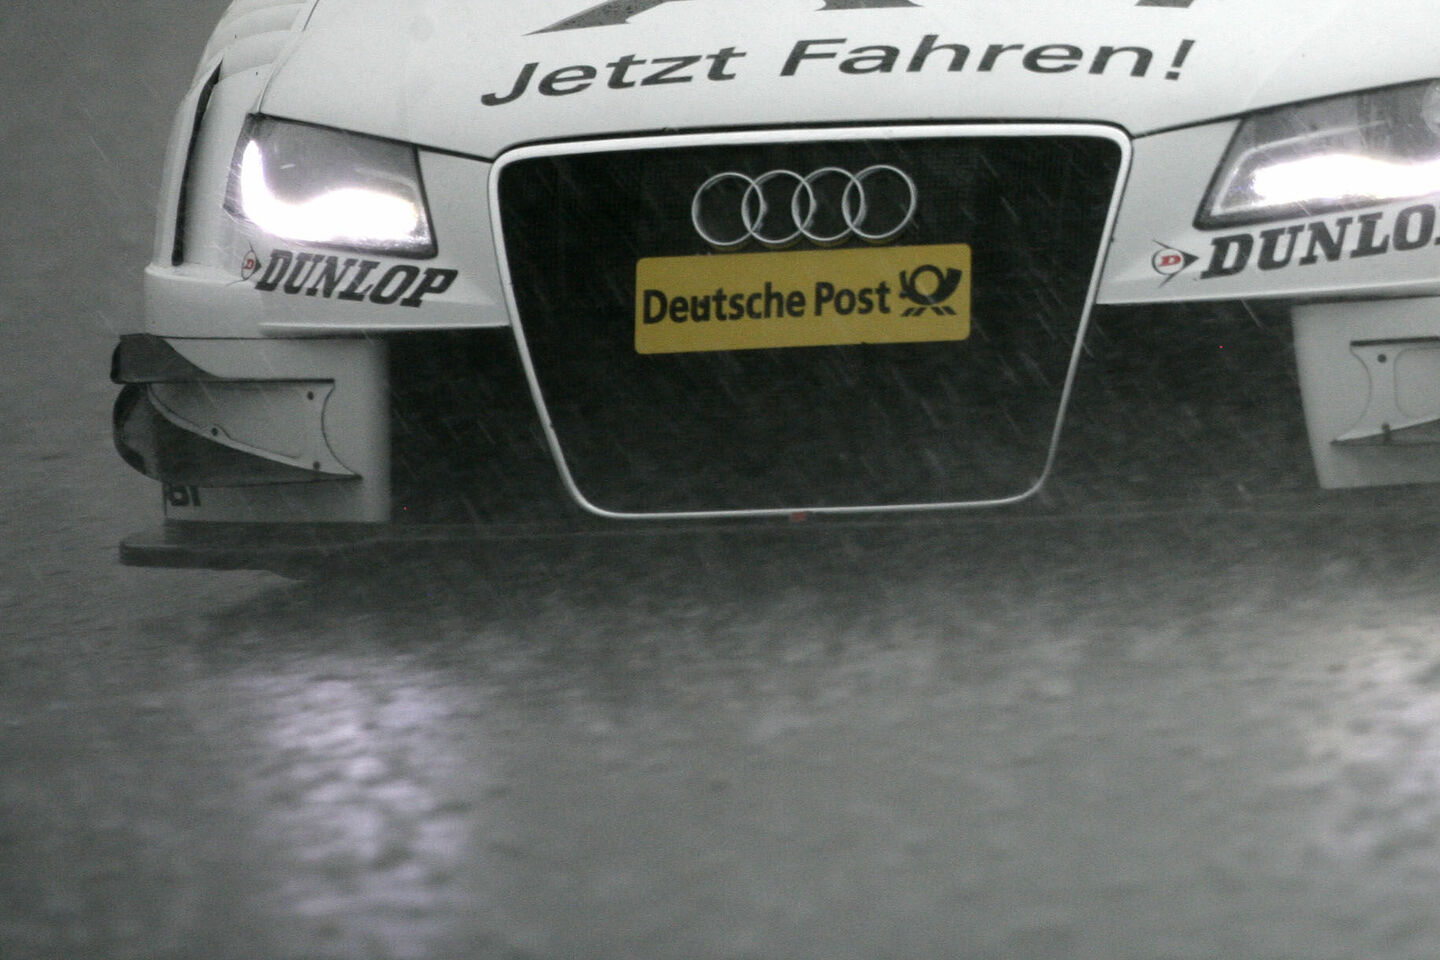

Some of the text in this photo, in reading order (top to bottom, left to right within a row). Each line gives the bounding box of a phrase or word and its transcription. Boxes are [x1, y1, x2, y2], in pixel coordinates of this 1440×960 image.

[481, 34, 1196, 107] Jetzt Fahren!
[254, 248, 458, 308] DUNLOP
[642, 278, 891, 325] Deutsche Post
